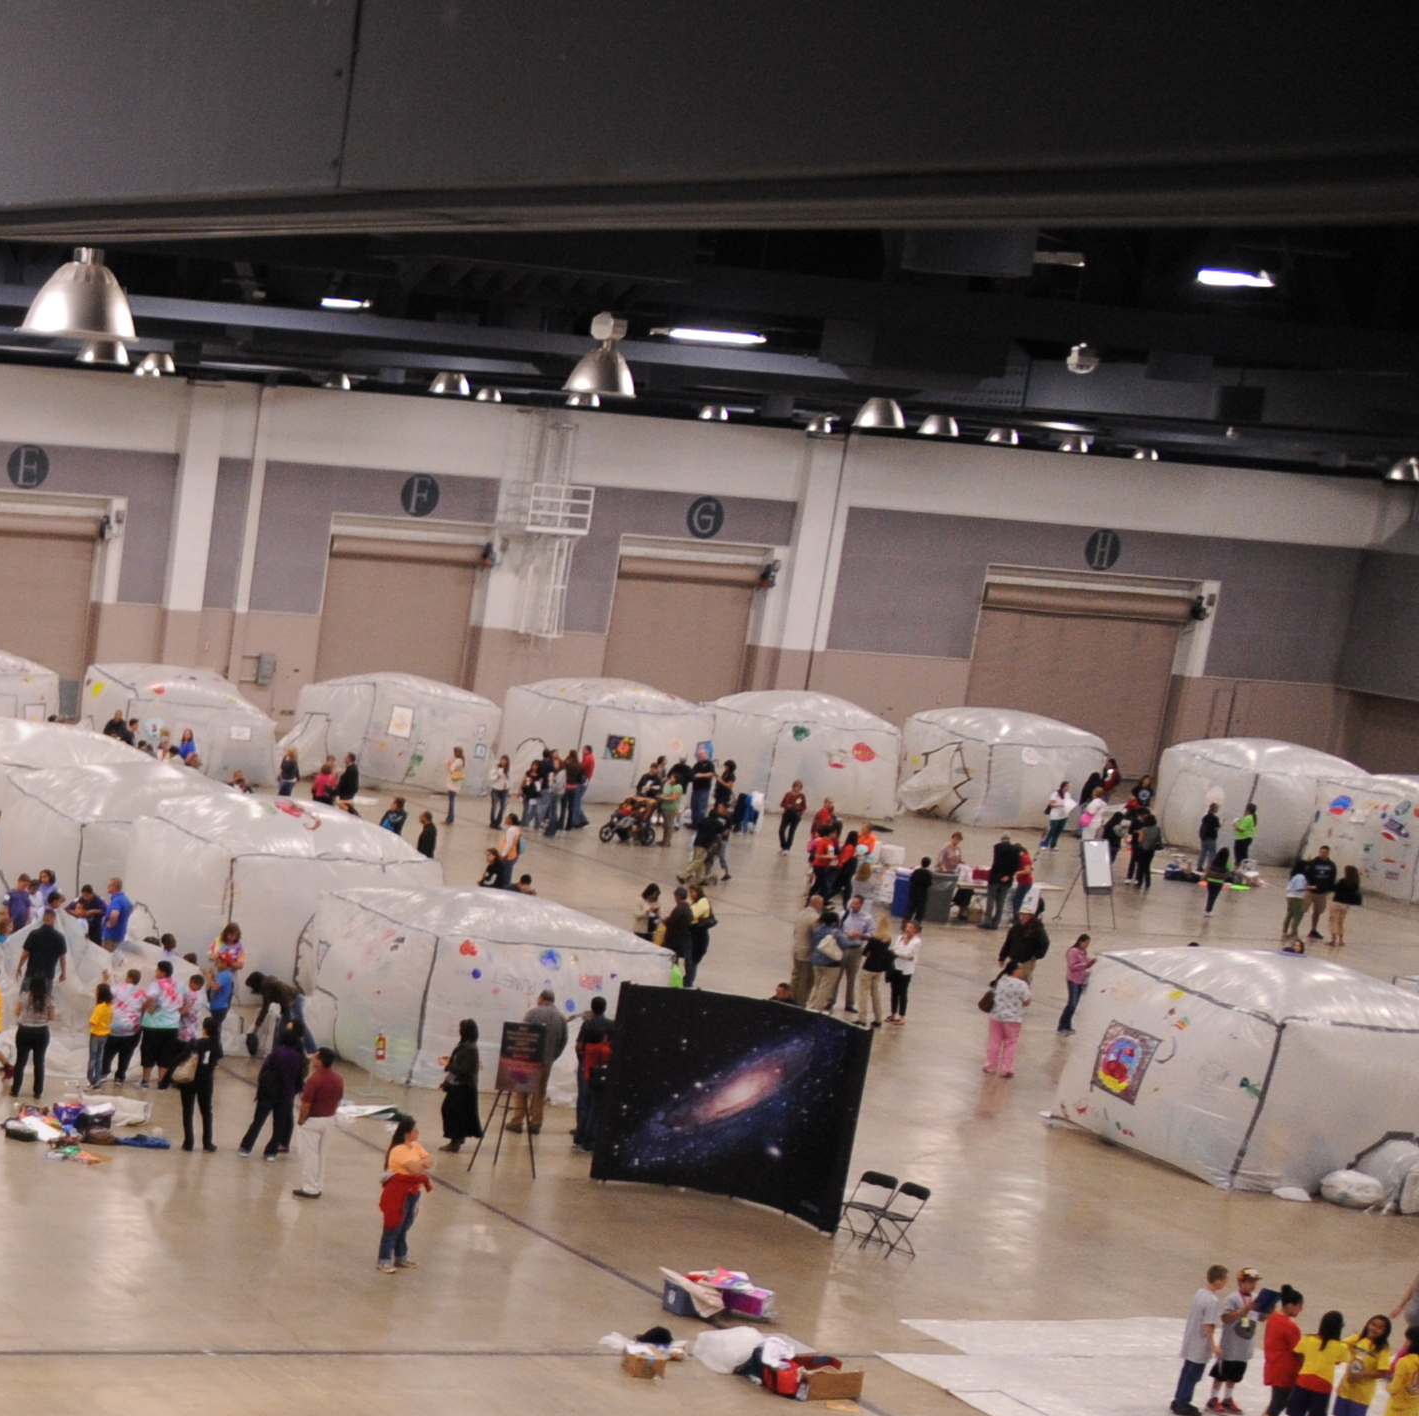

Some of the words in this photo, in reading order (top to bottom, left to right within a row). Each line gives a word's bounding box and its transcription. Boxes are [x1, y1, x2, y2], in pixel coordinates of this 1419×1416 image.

[17, 449, 39, 486] E
[409, 478, 431, 513] F
[693, 502, 716, 533] G
[1094, 533, 1114, 568] H
